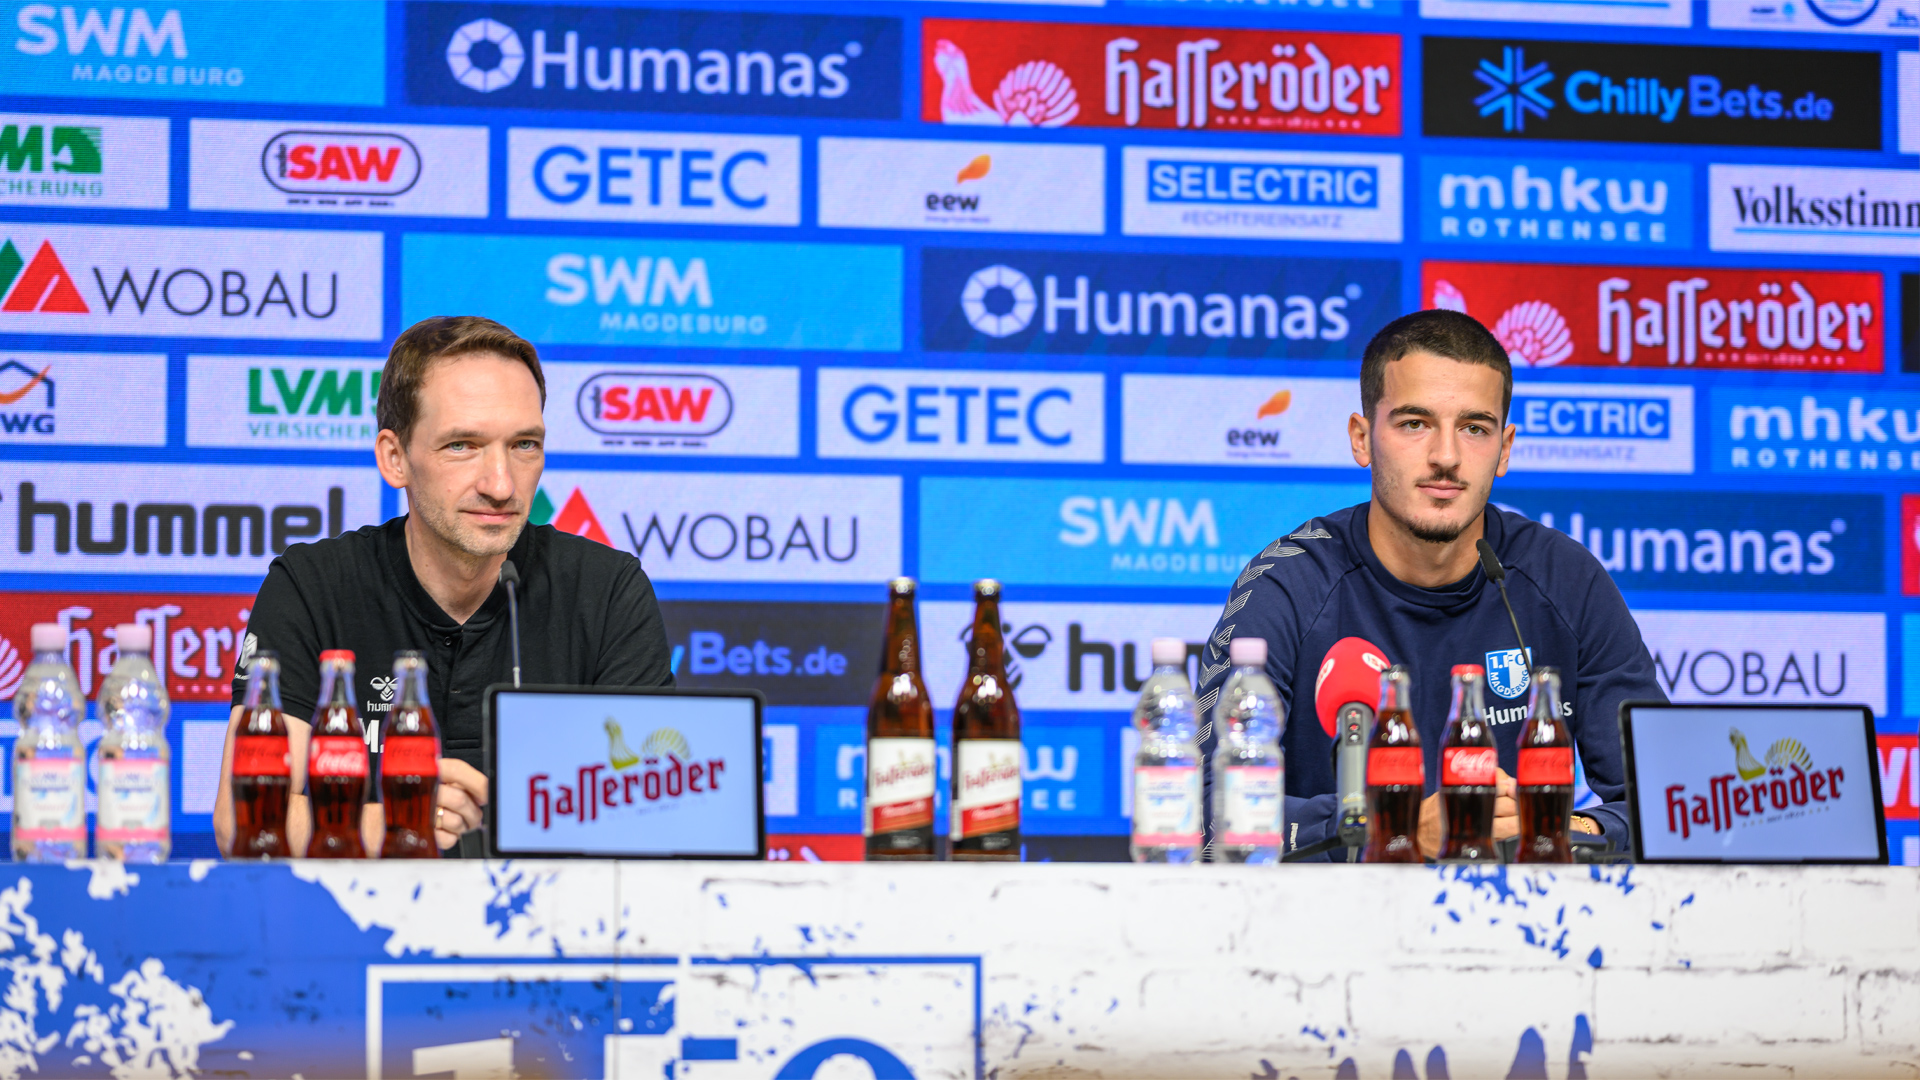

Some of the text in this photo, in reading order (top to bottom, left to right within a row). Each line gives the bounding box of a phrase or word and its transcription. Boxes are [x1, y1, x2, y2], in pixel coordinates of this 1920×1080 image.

[16, 4, 188, 59] SWM
[73, 63, 245, 86] MAGDEBURG
[532, 29, 849, 98] Humanas
[1564, 70, 1834, 122] ChillyBets.de
[287, 144, 402, 183] SAW
[533, 145, 768, 209] GETEC
[1152, 164, 1374, 205] SELECTRIC
[926, 194, 979, 211] eew
[1439, 165, 1668, 214] mhkw
[1441, 216, 1666, 242] ROTHENSEE
[93, 266, 338, 319] WOBAU
[546, 253, 713, 307] SWM
[601, 312, 767, 335] MAGDEBURG
[1044, 276, 1350, 341] Humanas
[249, 368, 363, 416] LVM
[603, 386, 713, 422] SAW
[842, 384, 1073, 447] GETEC
[0, 413, 55, 433] WG
[249, 422, 379, 438] VERSICHER
[1227, 429, 1279, 446] eew
[1514, 399, 1666, 436] ECTRIC
[18, 481, 345, 556] hummel
[622, 512, 858, 563] WOBAU
[1059, 496, 1219, 547] SWM
[1490, 669, 1529, 696] MAGDEBURG
